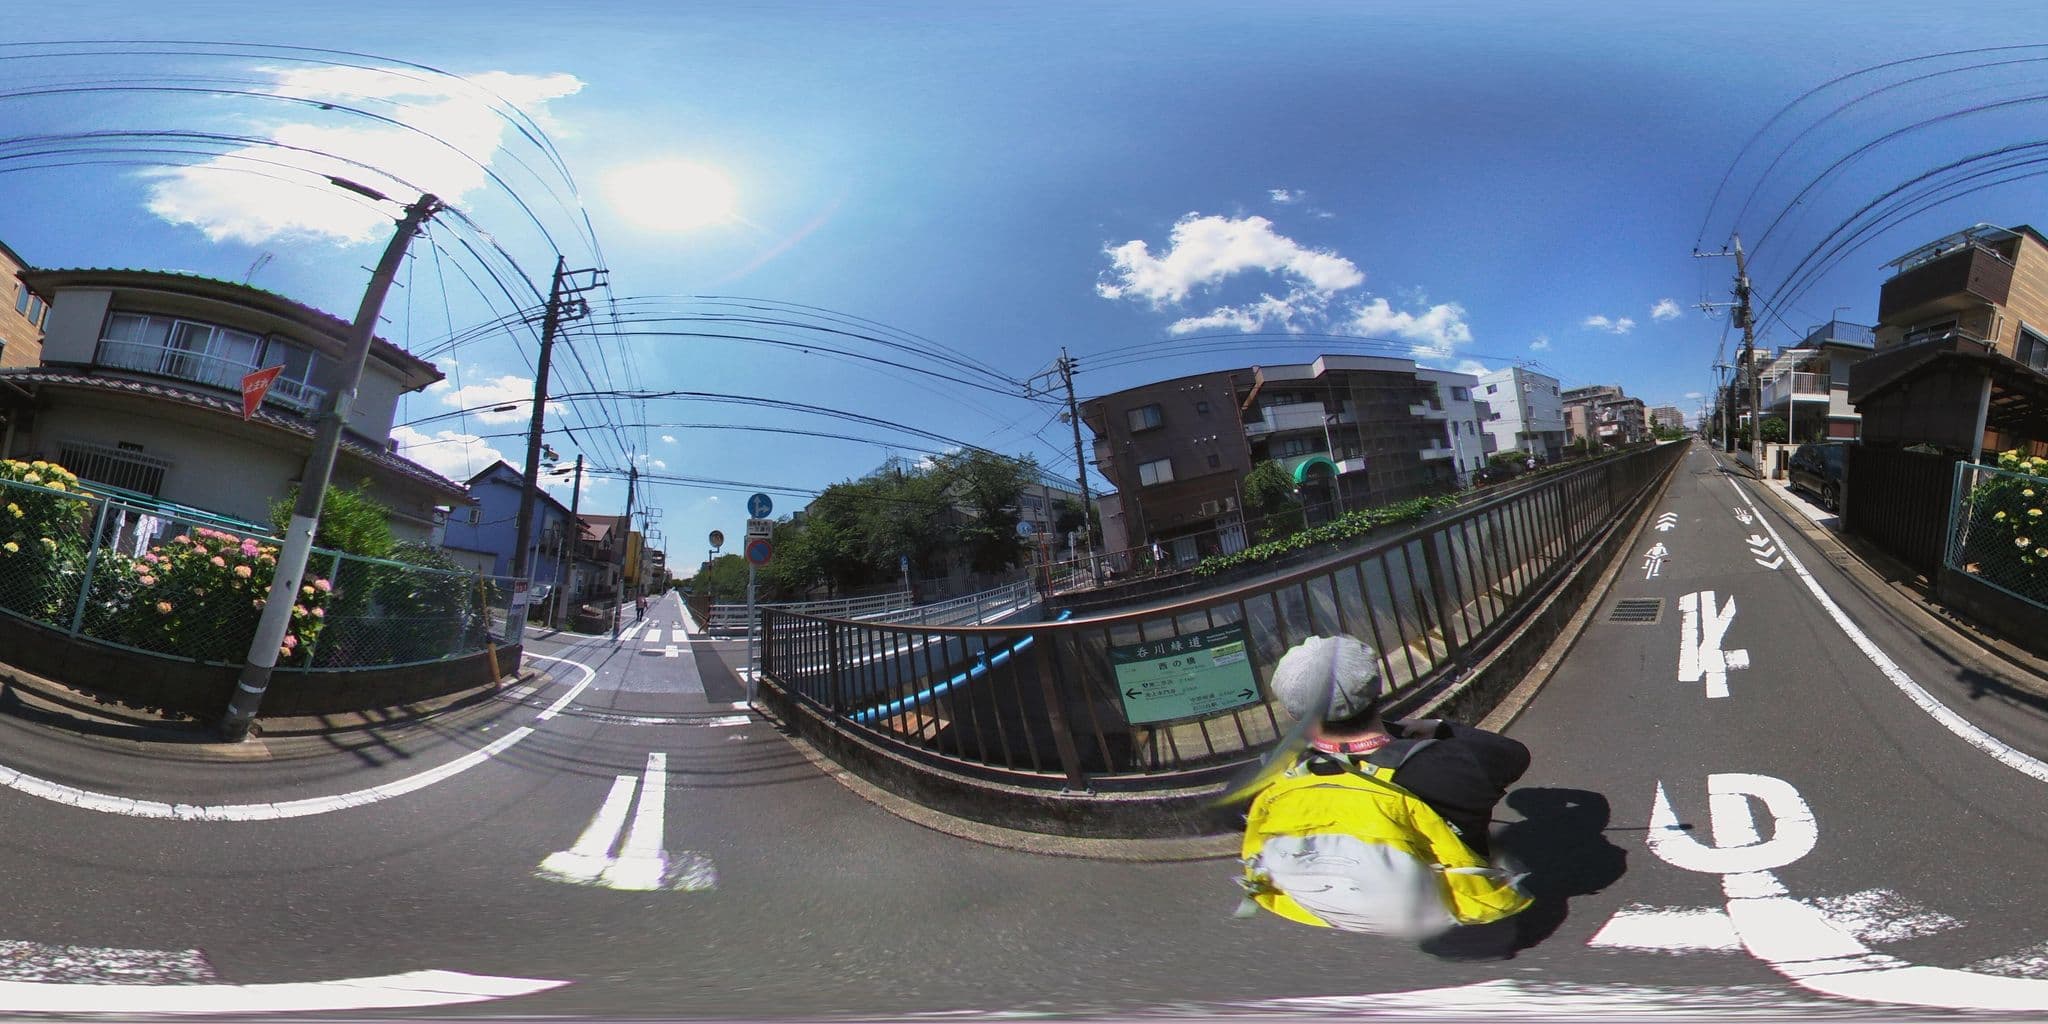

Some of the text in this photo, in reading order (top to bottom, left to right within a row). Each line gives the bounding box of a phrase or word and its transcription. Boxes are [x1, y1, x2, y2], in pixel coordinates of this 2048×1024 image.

[1136, 637, 1202, 657] 呑川緑道
[1158, 657, 1197, 671] 西の橋
